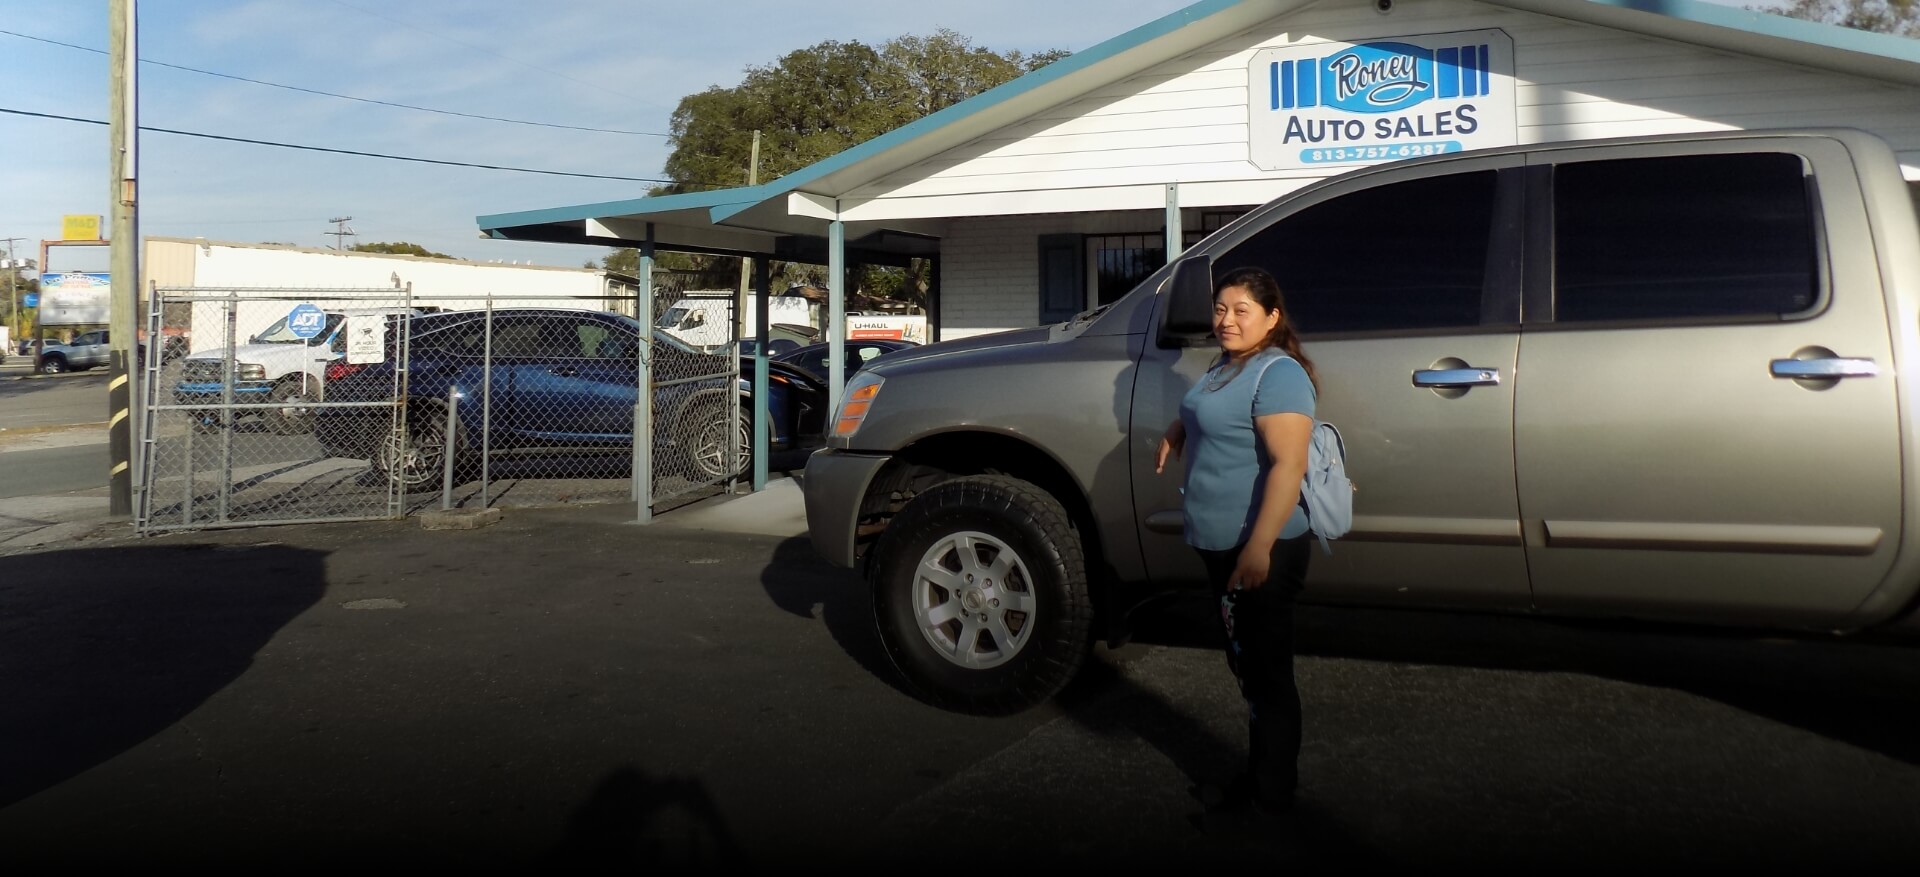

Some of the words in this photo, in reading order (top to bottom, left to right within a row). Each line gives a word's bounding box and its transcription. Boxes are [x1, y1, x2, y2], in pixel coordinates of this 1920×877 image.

[1330, 53, 1430, 104] Roney
[1282, 115, 1365, 144] AUTO
[1375, 104, 1478, 139] SALES
[1312, 143, 1447, 161] 813-757-6287
[291, 312, 322, 327] ADT
